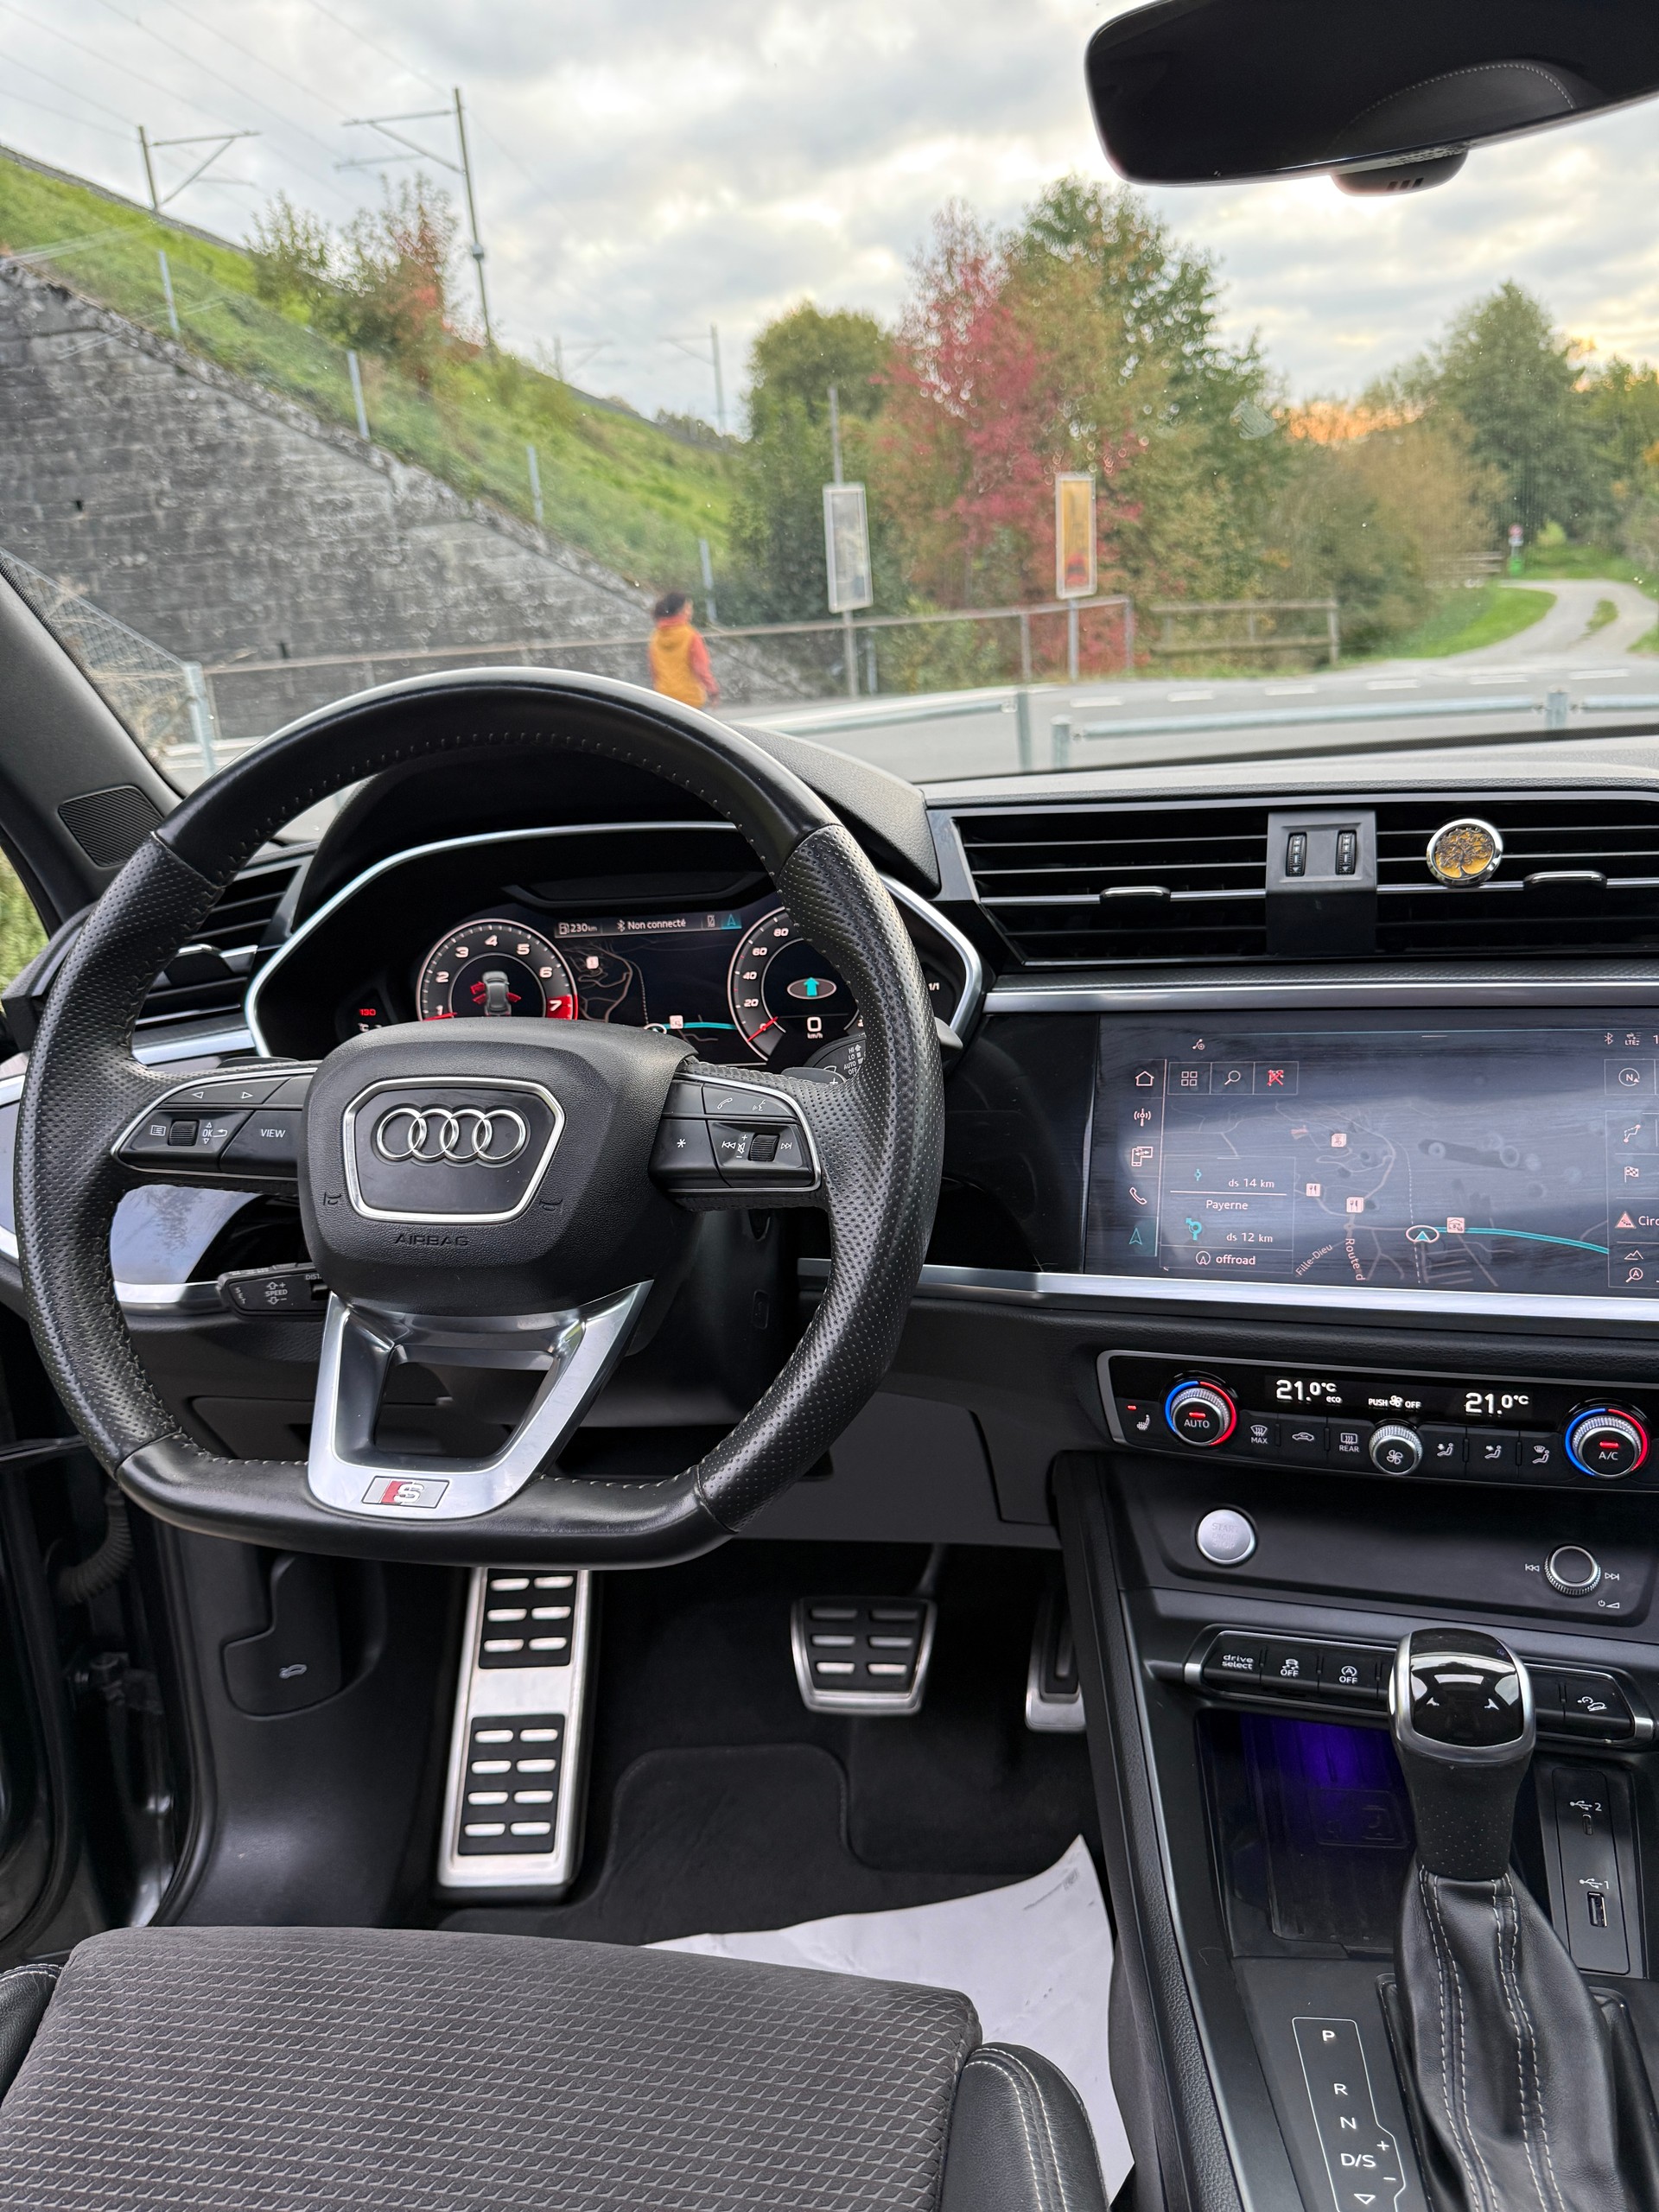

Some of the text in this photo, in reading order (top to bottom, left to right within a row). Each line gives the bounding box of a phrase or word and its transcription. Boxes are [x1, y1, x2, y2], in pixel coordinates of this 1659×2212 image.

[627, 918, 687, 931] Non connecté
[773, 928, 789, 937] 80
[485, 935, 498, 947] 4
[455, 946, 469, 958] 3
[517, 943, 530, 955] 5
[752, 947, 767, 956] 60
[435, 971, 449, 983] 2
[539, 967, 553, 978] 6
[742, 971, 757, 980] 40
[928, 982, 940, 991] 1/1
[549, 999, 562, 1012] 7
[744, 998, 759, 1007] 20
[435, 1005, 443, 1016] 1
[807, 1016, 822, 1032] 0
[843, 1061, 856, 1071] AUTO
[202, 1128, 213, 1137] OK
[261, 1128, 286, 1138] VIEW
[1228, 1178, 1274, 1188] ds 14 km
[1205, 1199, 1249, 1211] Payerne
[394, 1234, 469, 1246] AIRBAG
[1226, 1232, 1273, 1243] ds 12 km
[1345, 1238, 1360, 1270] Route
[1216, 1254, 1256, 1265] offroad
[1295, 1244, 1333, 1276] Fille-Dieu
[265, 1288, 288, 1297] SPEED
[1325, 1395, 1342, 1404] eco
[1368, 1398, 1421, 1409] PUSH OFF
[1184, 1419, 1210, 1428] AUTO
[1339, 1444, 1360, 1452] REAR
[1599, 1452, 1618, 1460] A/C
[1223, 1654, 1254, 1663] drive
[1222, 1660, 1253, 1670] select
[1281, 1669, 1300, 1677] OFF
[1339, 1675, 1358, 1684] OFF
[1594, 1802, 1602, 1812] 2
[1604, 1880, 1610, 1890] 1
[1322, 2030, 1335, 2042] P
[1333, 2083, 1348, 2096] R
[1340, 2117, 1357, 2130] N
[1340, 2153, 1376, 2168] D/S
